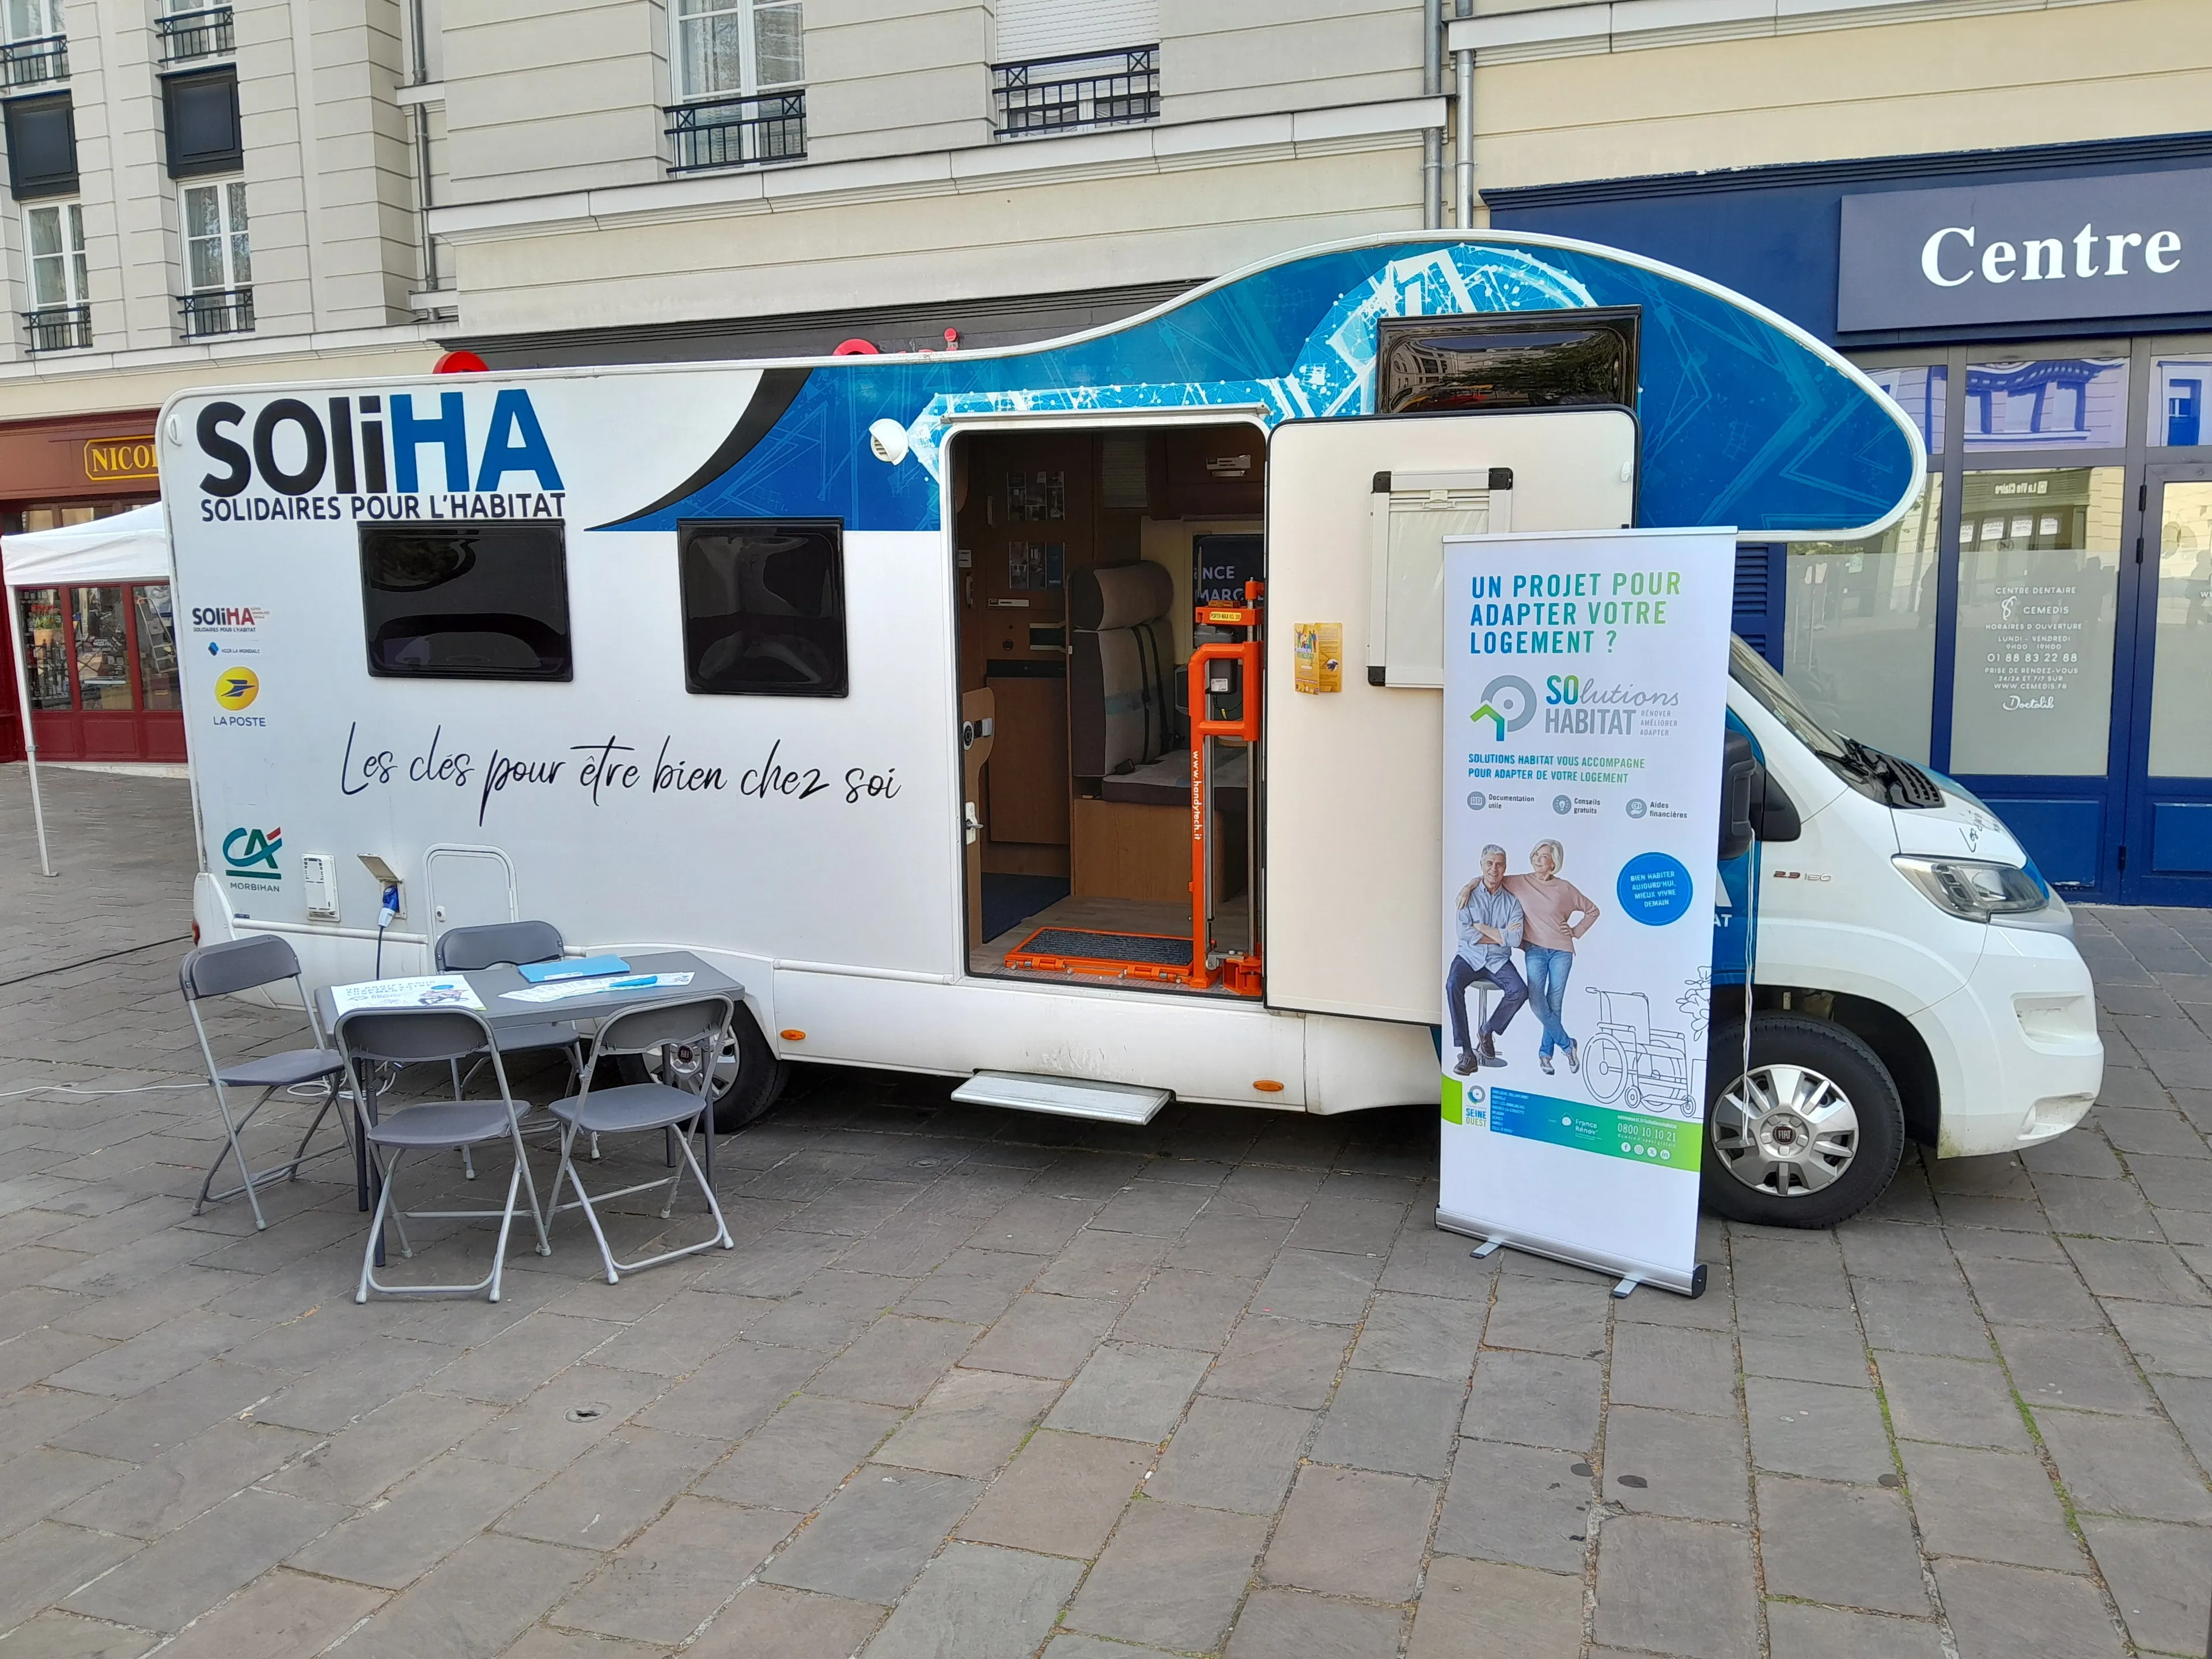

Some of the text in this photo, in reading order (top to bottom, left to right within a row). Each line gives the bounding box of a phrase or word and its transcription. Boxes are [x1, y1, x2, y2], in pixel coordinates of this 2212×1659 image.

[1921, 222, 2182, 287] Centre
[200, 492, 566, 522] SOLIDAIRES POUR L'HABITAT
[1472, 572, 1681, 599] UN PROJET POUR
[1471, 601, 1667, 626] ADAPTER VOTRE
[2023, 606, 2069, 614] CEMEDIS
[1471, 630, 1617, 654] LOGEMENT ?
[1987, 653, 2078, 662] 01 88 83 22 88
[2002, 695, 2055, 711] Doctolib
[213, 716, 266, 727] LA POSTE
[1545, 709, 1637, 736] HABITAT
[1468, 753, 1645, 768] SOLUTIONS HABITAT VOUS ACCOMPAGNE
[342, 721, 902, 827] Les clés pour être bien chez soi
[1468, 768, 1628, 783] POUR ADAPTER DE VOTRE LOGEMENT
[1192, 750, 1203, 841] www.handytech.it
[1488, 794, 1535, 802] Documentation
[1630, 870, 1675, 882] BIEN HABITER
[230, 882, 280, 893] MORBIHAN
[1634, 889, 1677, 899] MIEUX VIVRE
[1644, 899, 1669, 908] DEMAIN
[1466, 1108, 1487, 1119] SEINE
[1466, 1117, 1487, 1127] OUEST
[1575, 1119, 1597, 1128] France
[1618, 1123, 1676, 1142] 0800 10 10 21
[1778, 1130, 1791, 1140] FIAT
